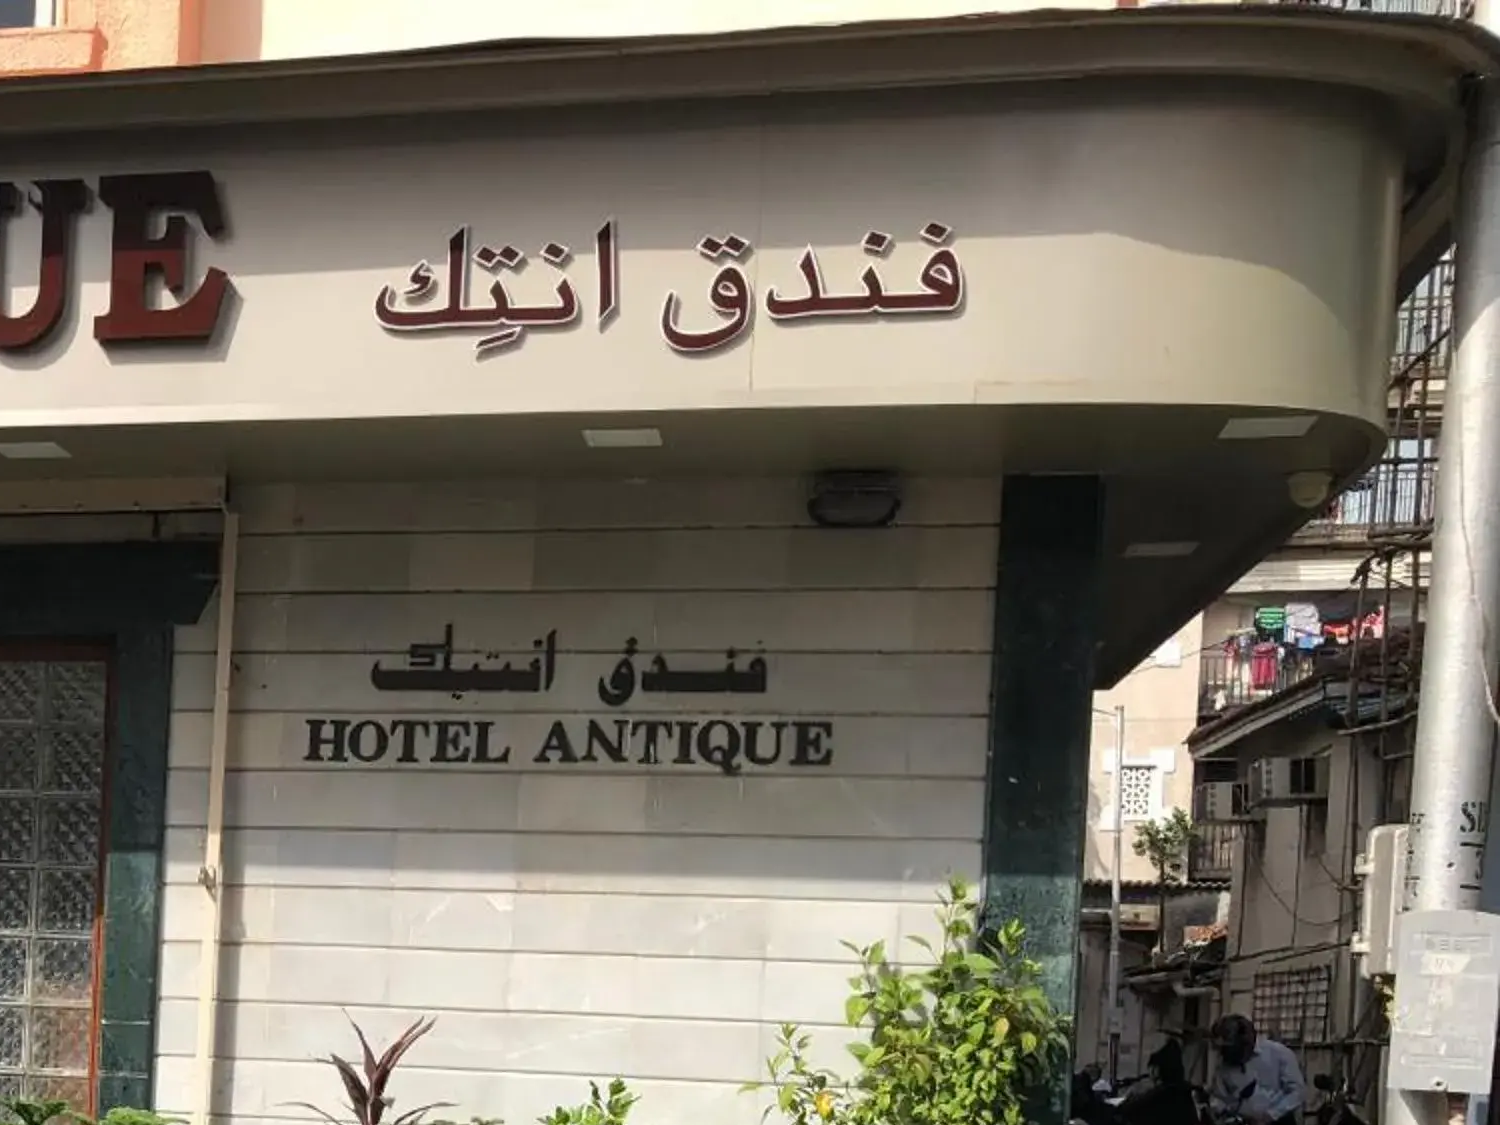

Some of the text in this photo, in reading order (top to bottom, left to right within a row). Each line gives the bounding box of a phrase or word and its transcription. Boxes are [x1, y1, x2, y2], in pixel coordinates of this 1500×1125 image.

[660, 221, 964, 352] فندق
[598, 636, 768, 706] فندق
[303, 719, 834, 775] HOTEL ANTIQUE
